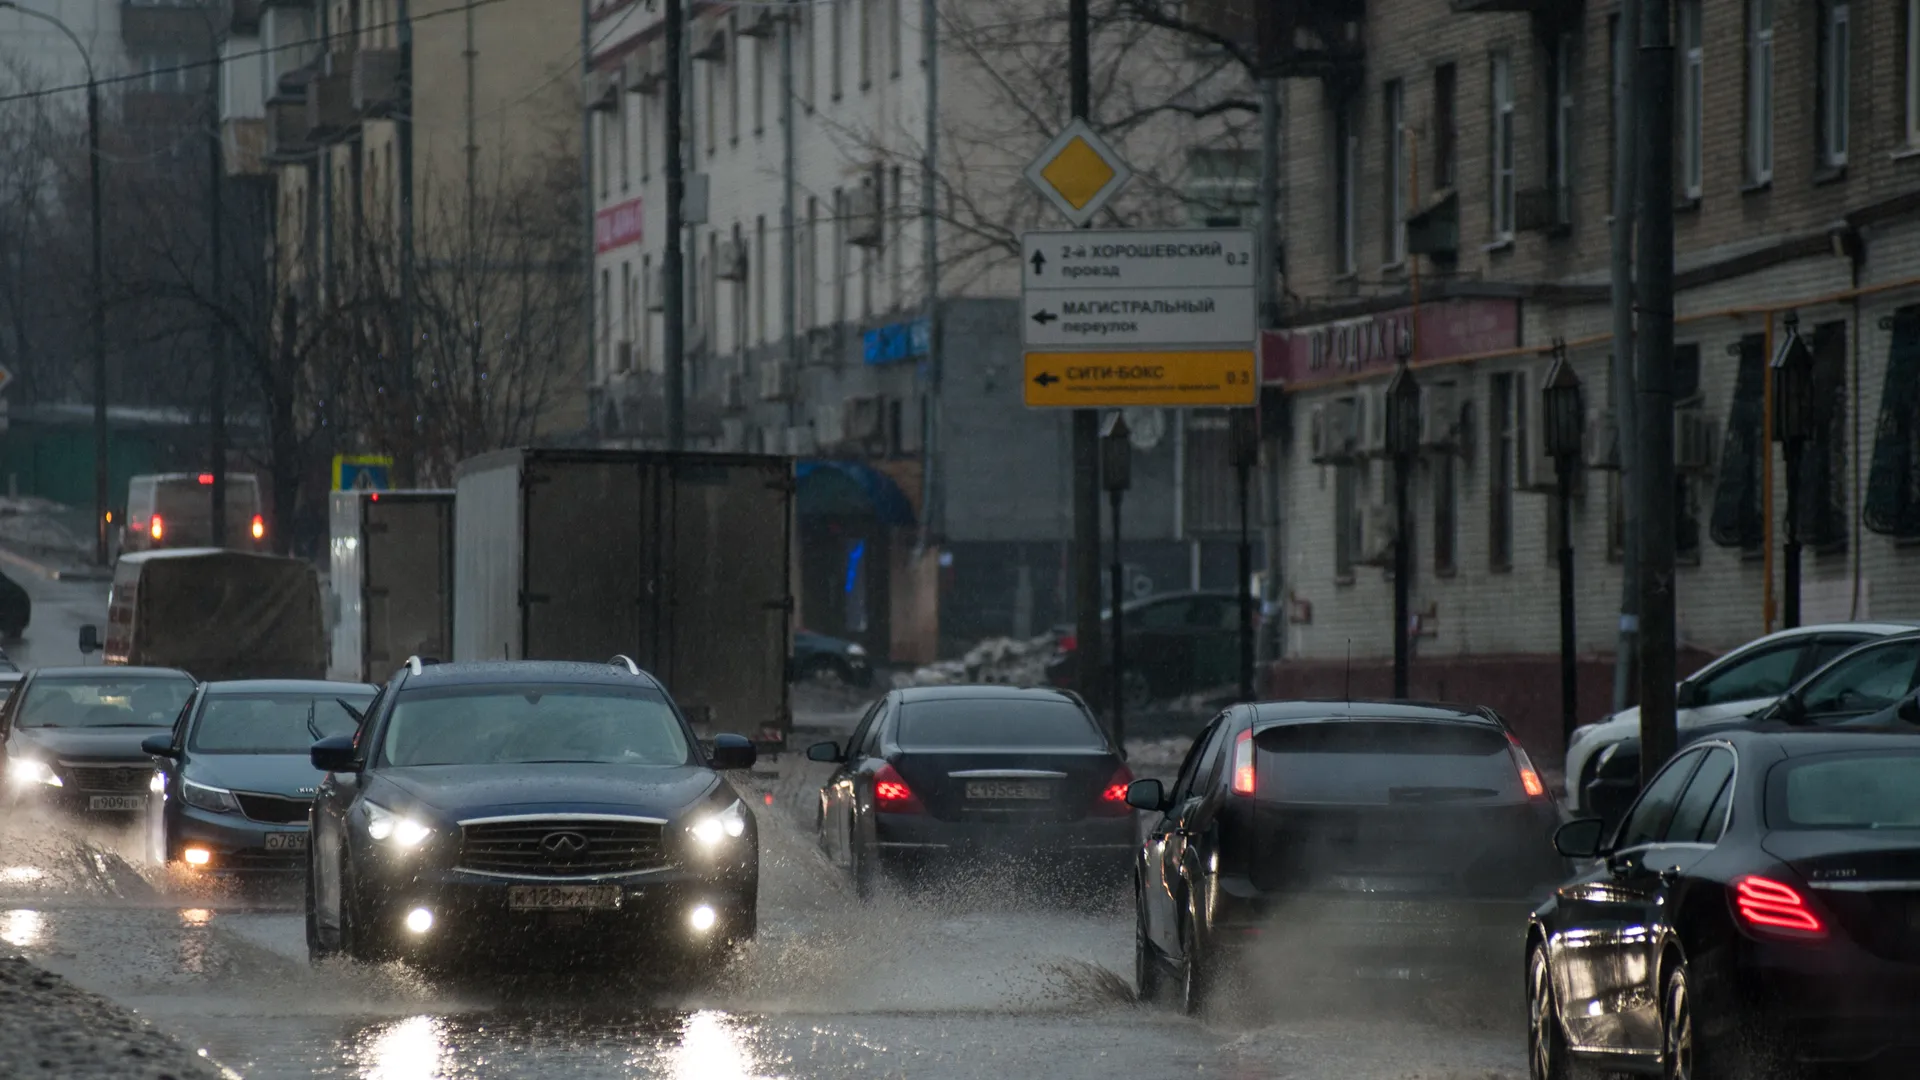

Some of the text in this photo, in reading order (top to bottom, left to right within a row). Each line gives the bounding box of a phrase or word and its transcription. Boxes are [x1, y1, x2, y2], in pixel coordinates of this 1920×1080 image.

[1061, 242, 1222, 258] 2-й ХОРОШЕВСКИЙ
[1226, 252, 1250, 266] 0.2
[1061, 265, 1120, 278] проезд
[1062, 298, 1216, 315] МАГИСТРАЛЬНЫЙ
[1062, 321, 1139, 335] переулок
[1065, 365, 1165, 380] СИТИ-БОКС
